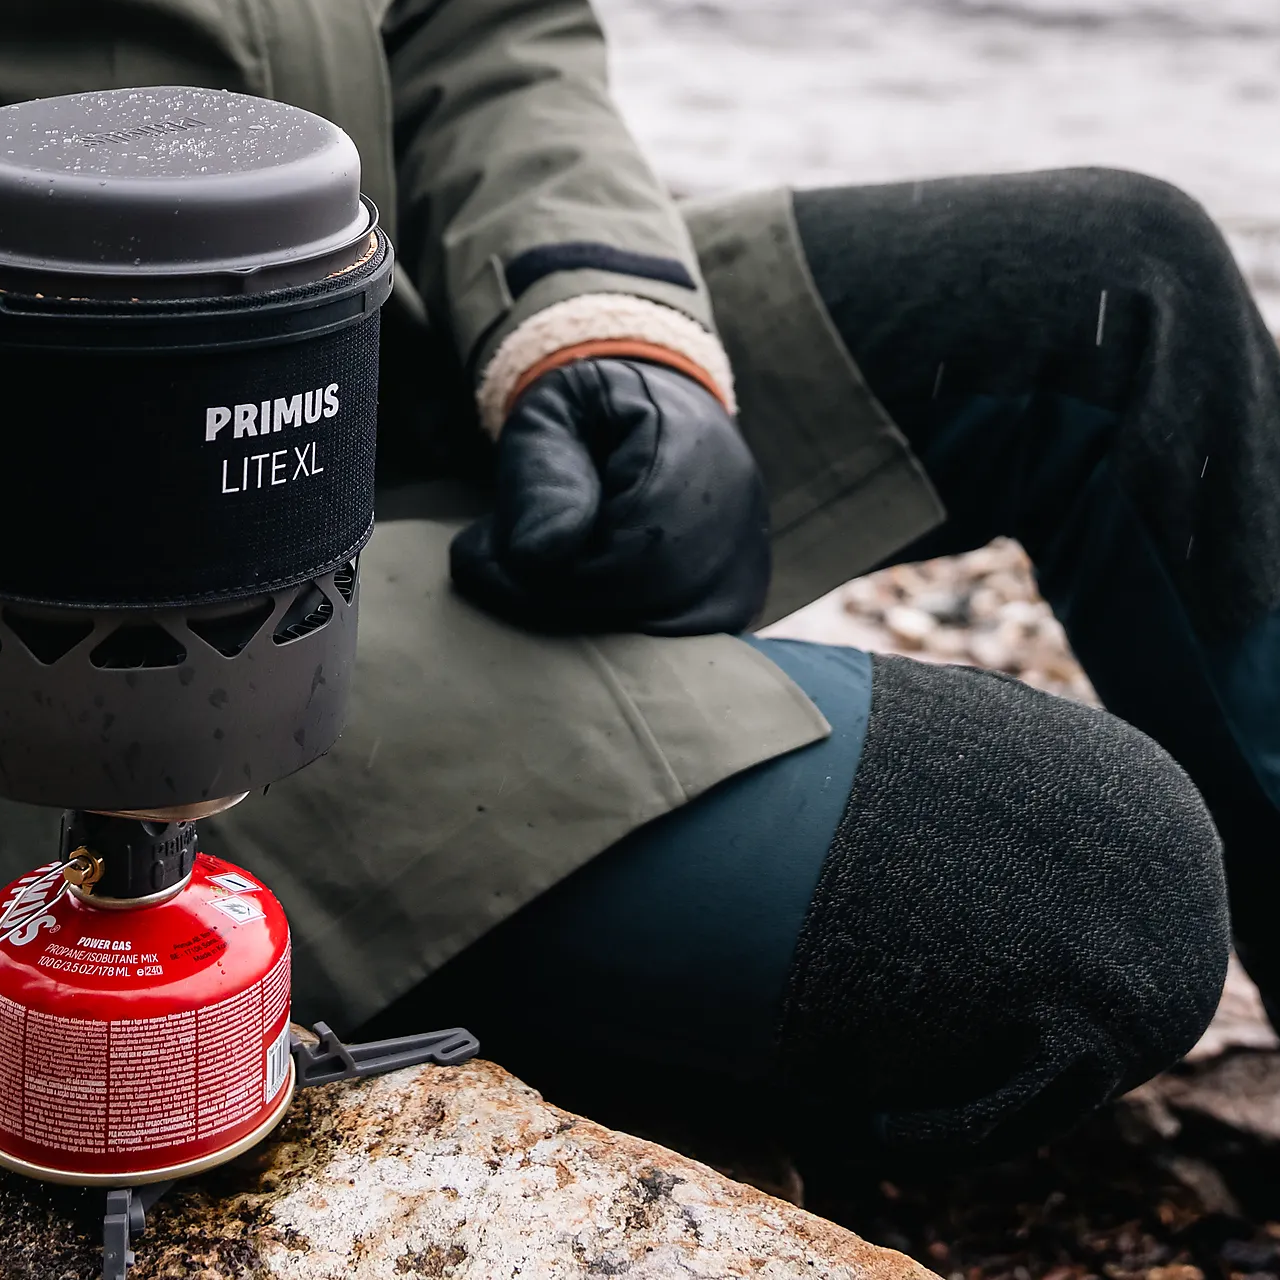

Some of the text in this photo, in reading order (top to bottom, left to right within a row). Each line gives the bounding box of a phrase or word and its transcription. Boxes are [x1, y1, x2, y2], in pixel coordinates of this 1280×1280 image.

[205, 382, 339, 442] PRIMUS
[221, 441, 324, 494] LITE XL
[45, 943, 159, 964] PROPANE/ISOBUTANE MIX
[77, 936, 132, 951] POWER GAS
